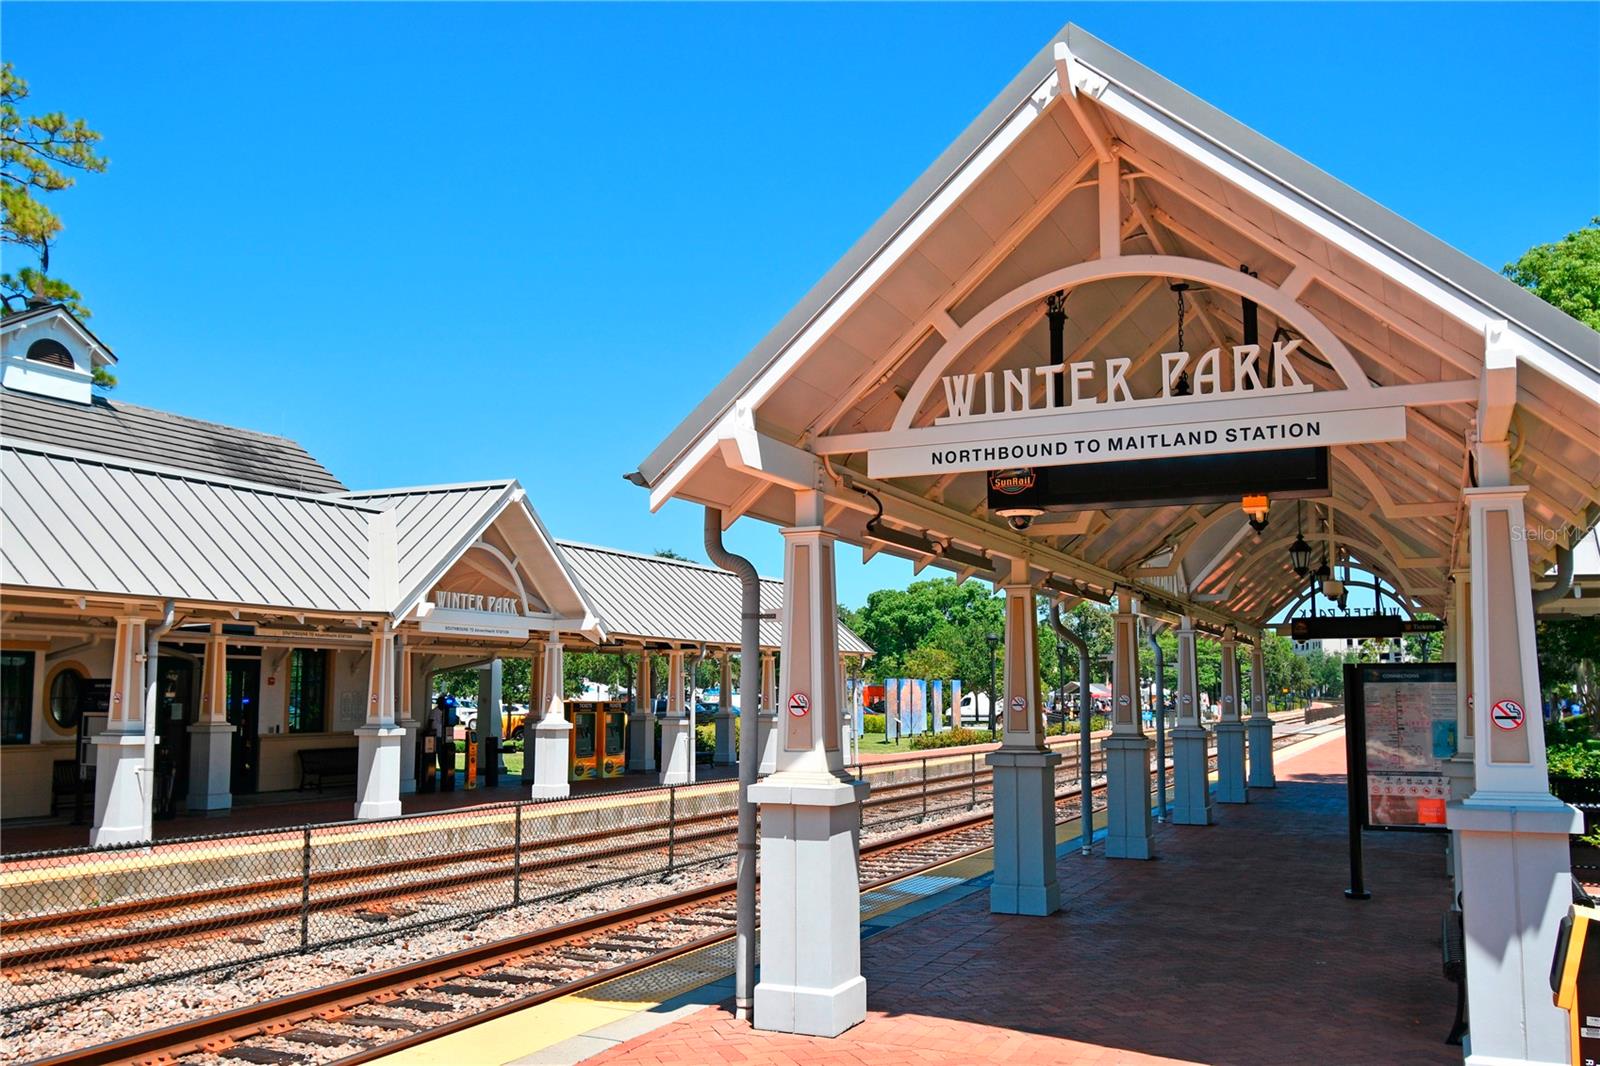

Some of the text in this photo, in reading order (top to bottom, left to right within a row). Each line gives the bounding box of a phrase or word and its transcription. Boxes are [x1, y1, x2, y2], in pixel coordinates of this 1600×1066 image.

[941, 339, 1311, 419] WINTER PARK
[931, 421, 1321, 465] NORTHBOUND TO MAITLAND STATION
[995, 476, 1030, 487] SunRail
[436, 590, 519, 616] WINTER PARK
